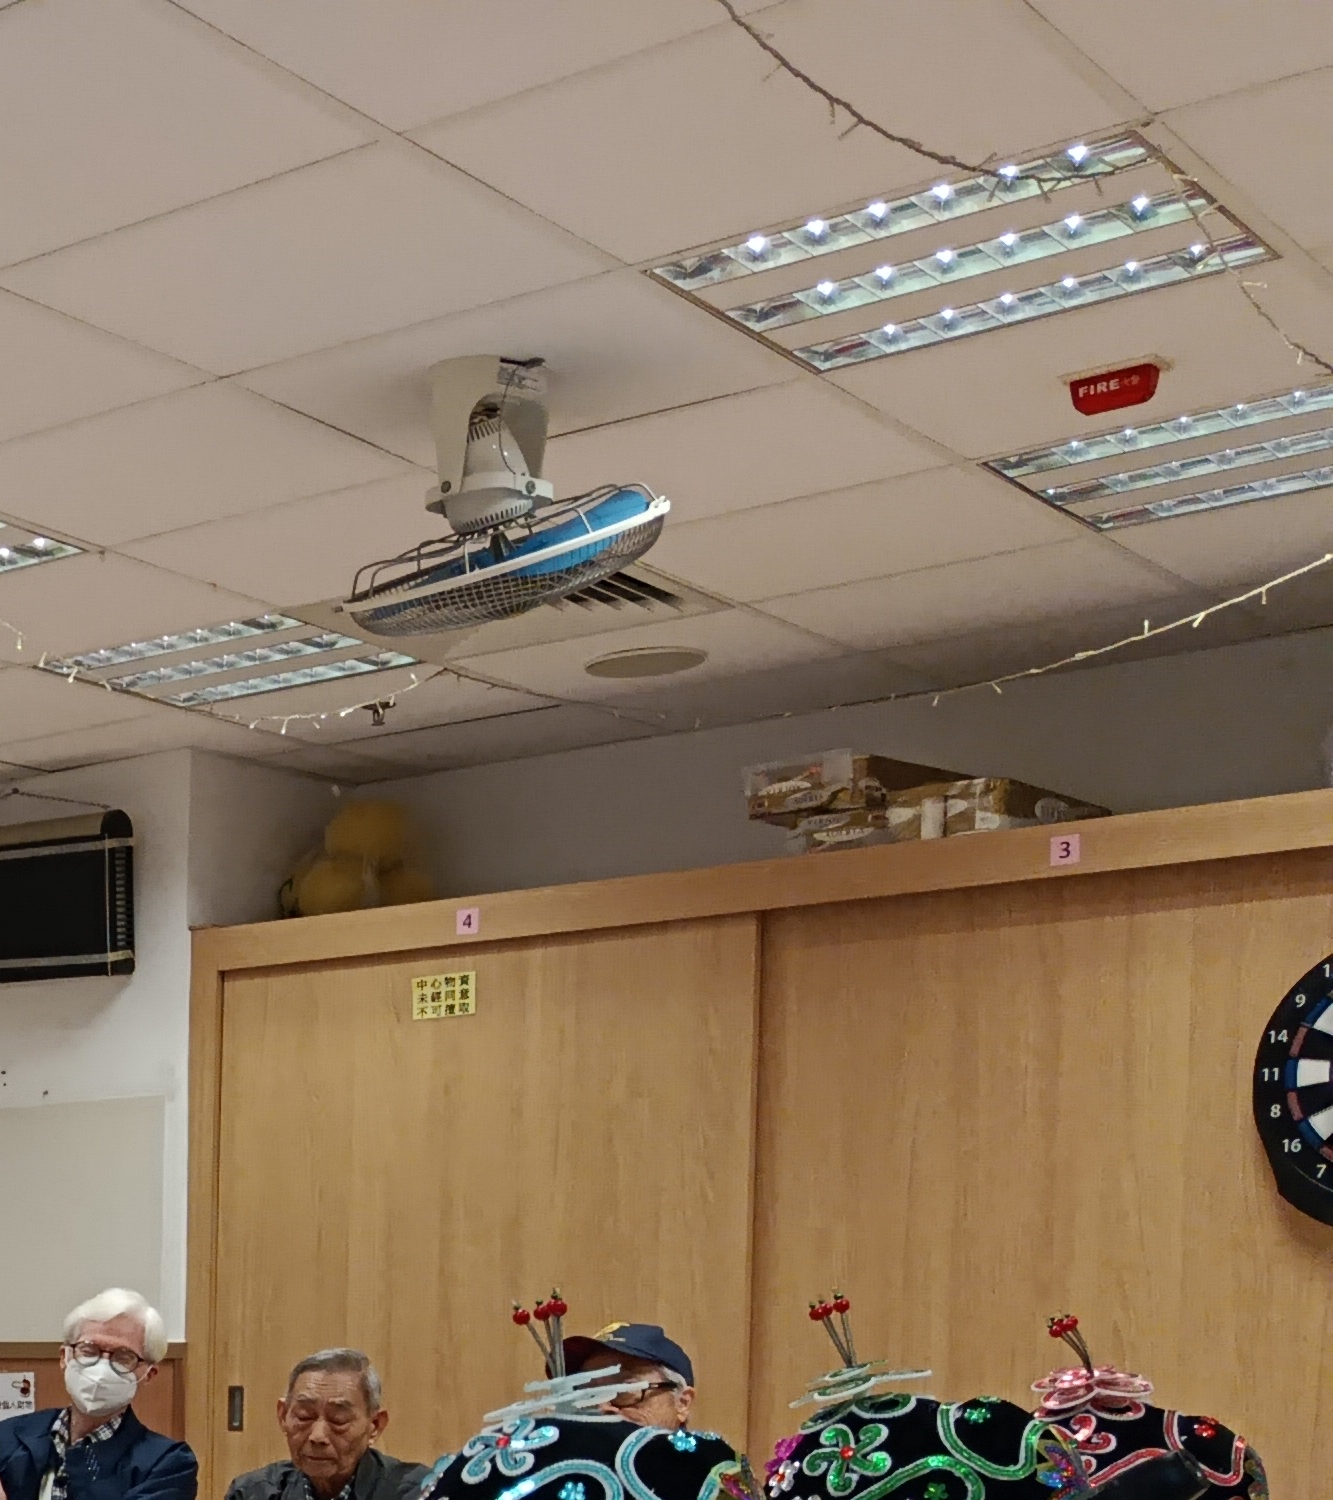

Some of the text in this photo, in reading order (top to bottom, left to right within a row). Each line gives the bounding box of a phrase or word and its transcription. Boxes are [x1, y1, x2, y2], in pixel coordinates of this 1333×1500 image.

[1078, 378, 1121, 398] FIRE
[1059, 842, 1071, 859] 3
[462, 913, 472, 929] 4
[1323, 963, 1333, 978] 1
[416, 975, 470, 991] 中心物資
[418, 988, 470, 1004] 未經同意
[1295, 994, 1306, 1008] 9
[1268, 1029, 1288, 1043] 14
[1262, 1068, 1280, 1081] 11
[1270, 1103, 1281, 1118] 8
[1282, 1138, 1302, 1153] 16
[1316, 1163, 1327, 1178] 7
